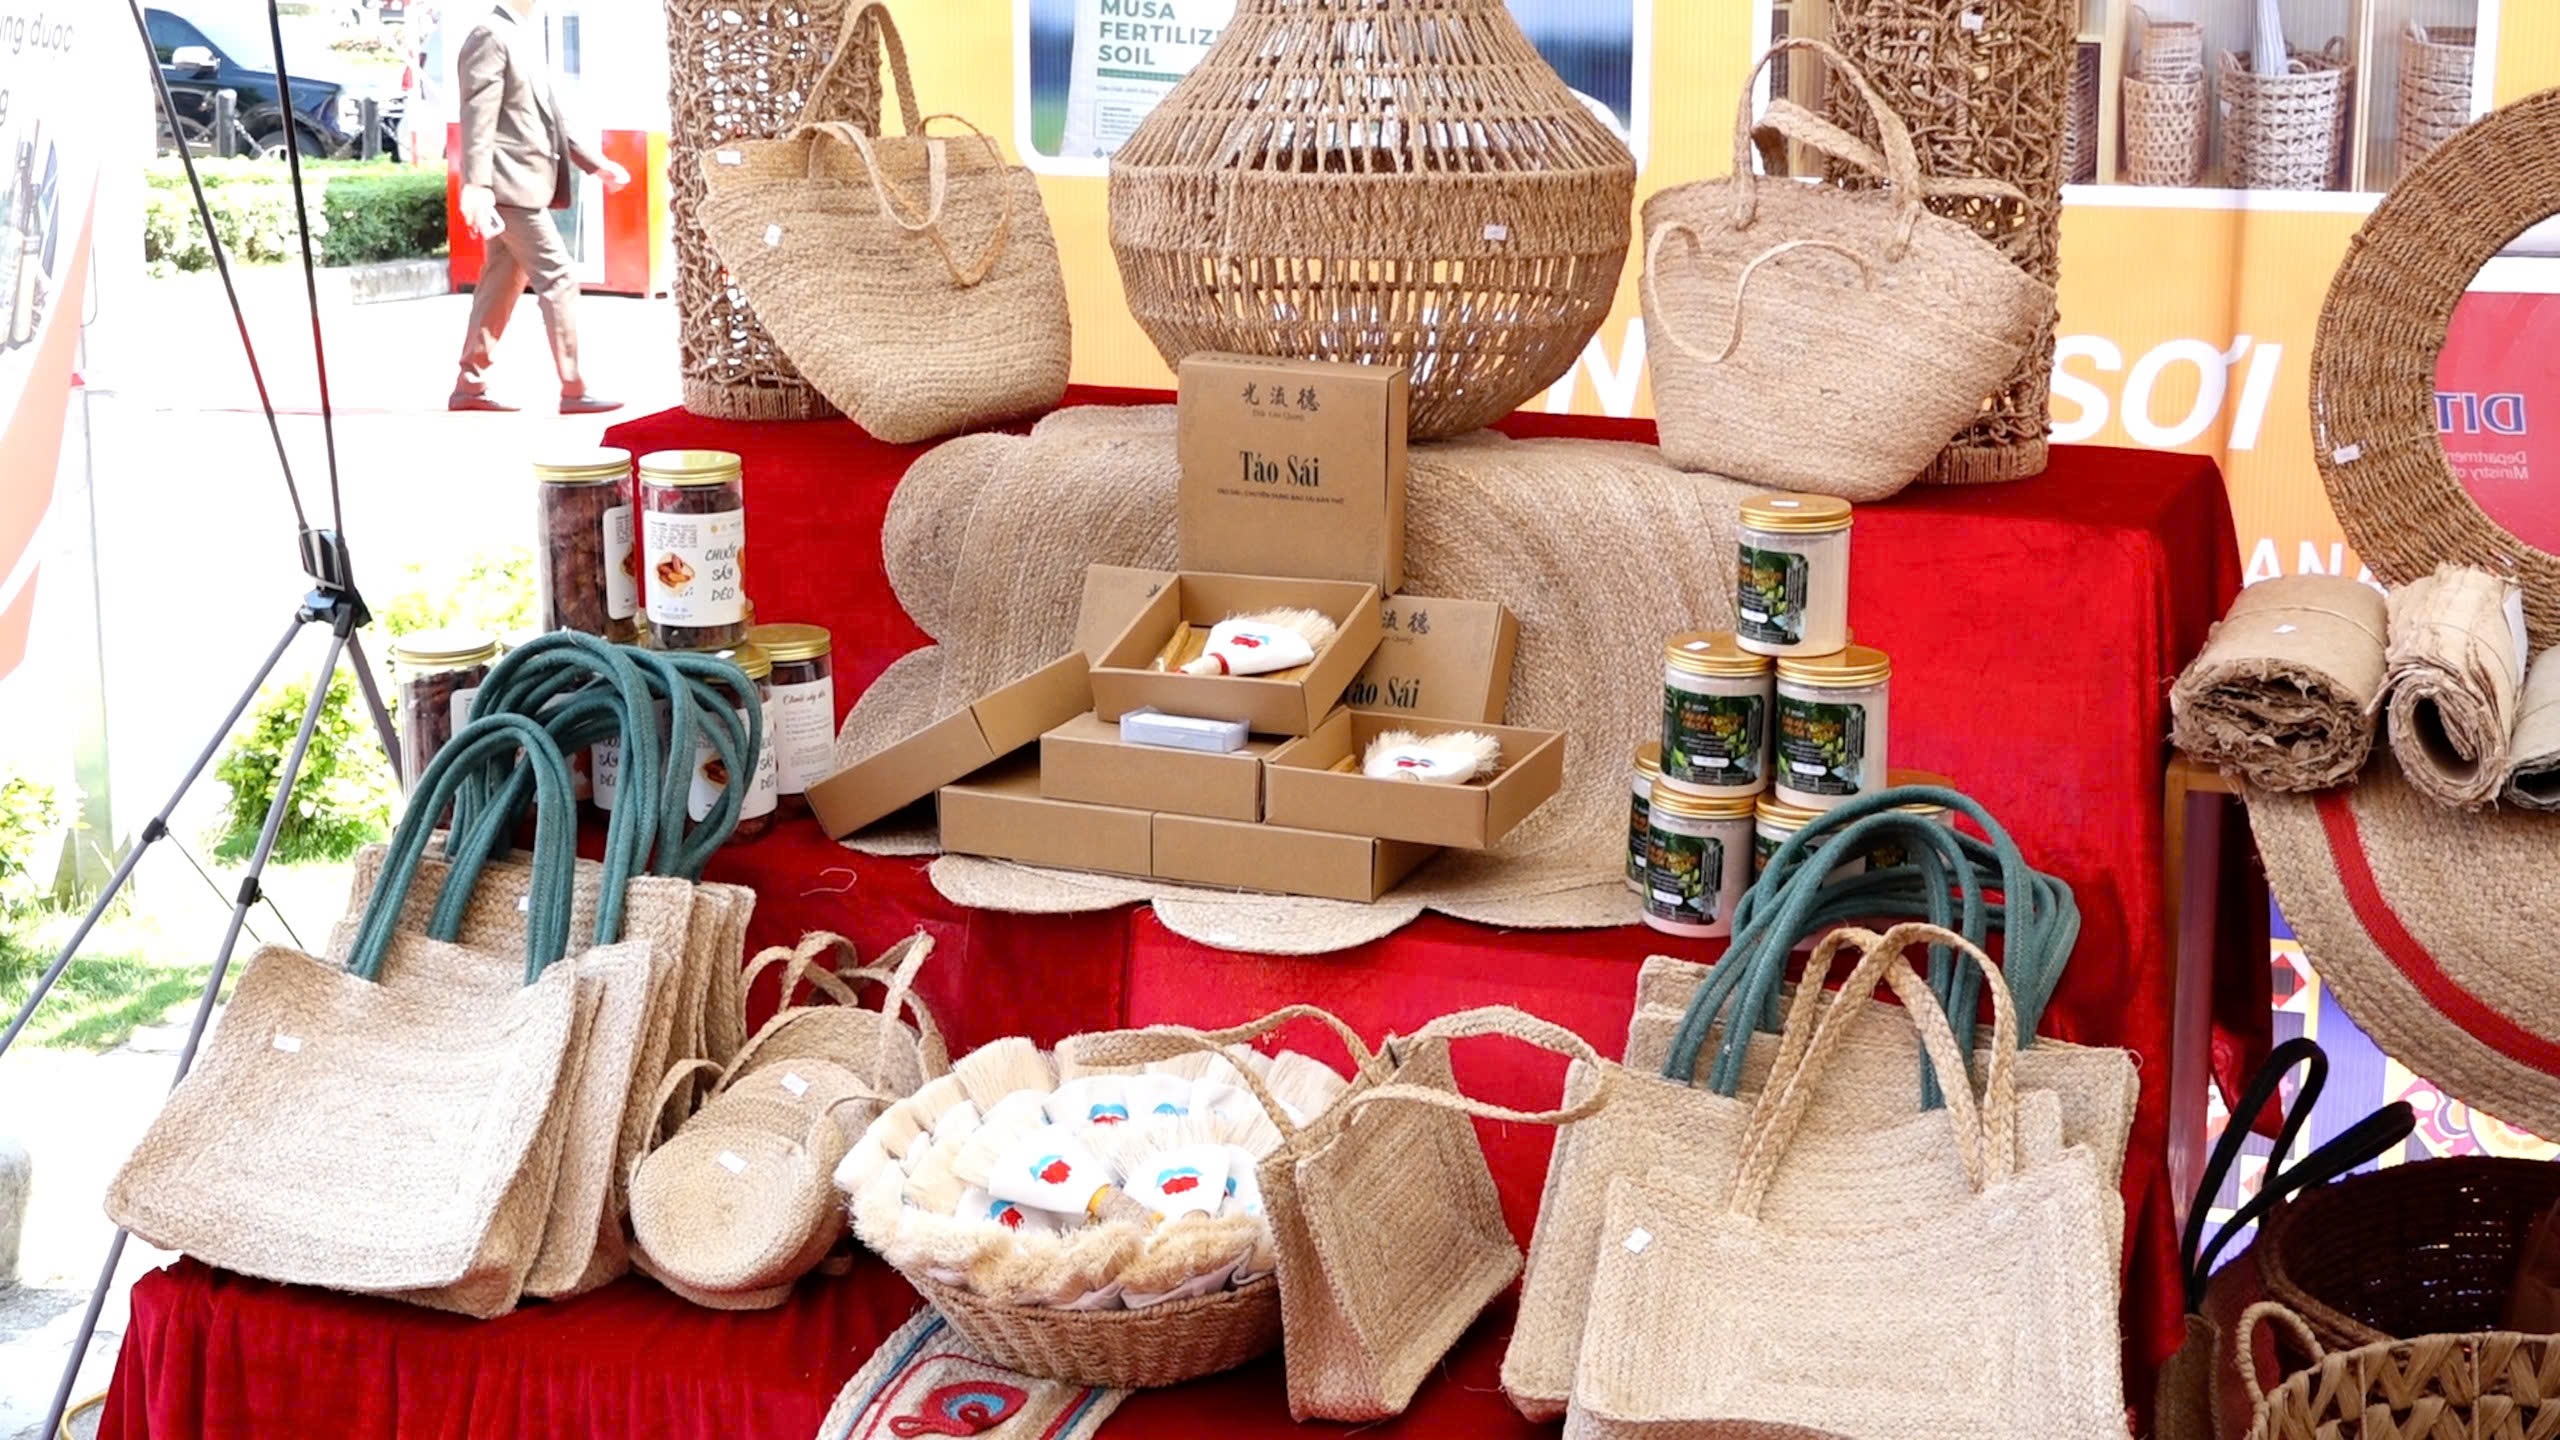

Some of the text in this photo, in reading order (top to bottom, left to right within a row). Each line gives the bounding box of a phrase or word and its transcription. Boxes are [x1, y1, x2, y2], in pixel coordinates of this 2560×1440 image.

[1101, 0, 1175, 19] MUSA
[1100, 21, 1222, 46] FERTILIZ
[1098, 45, 1155, 65] SOIL
[1240, 451, 1319, 487] Táo Sái
[1384, 676, 1419, 708] Sái
